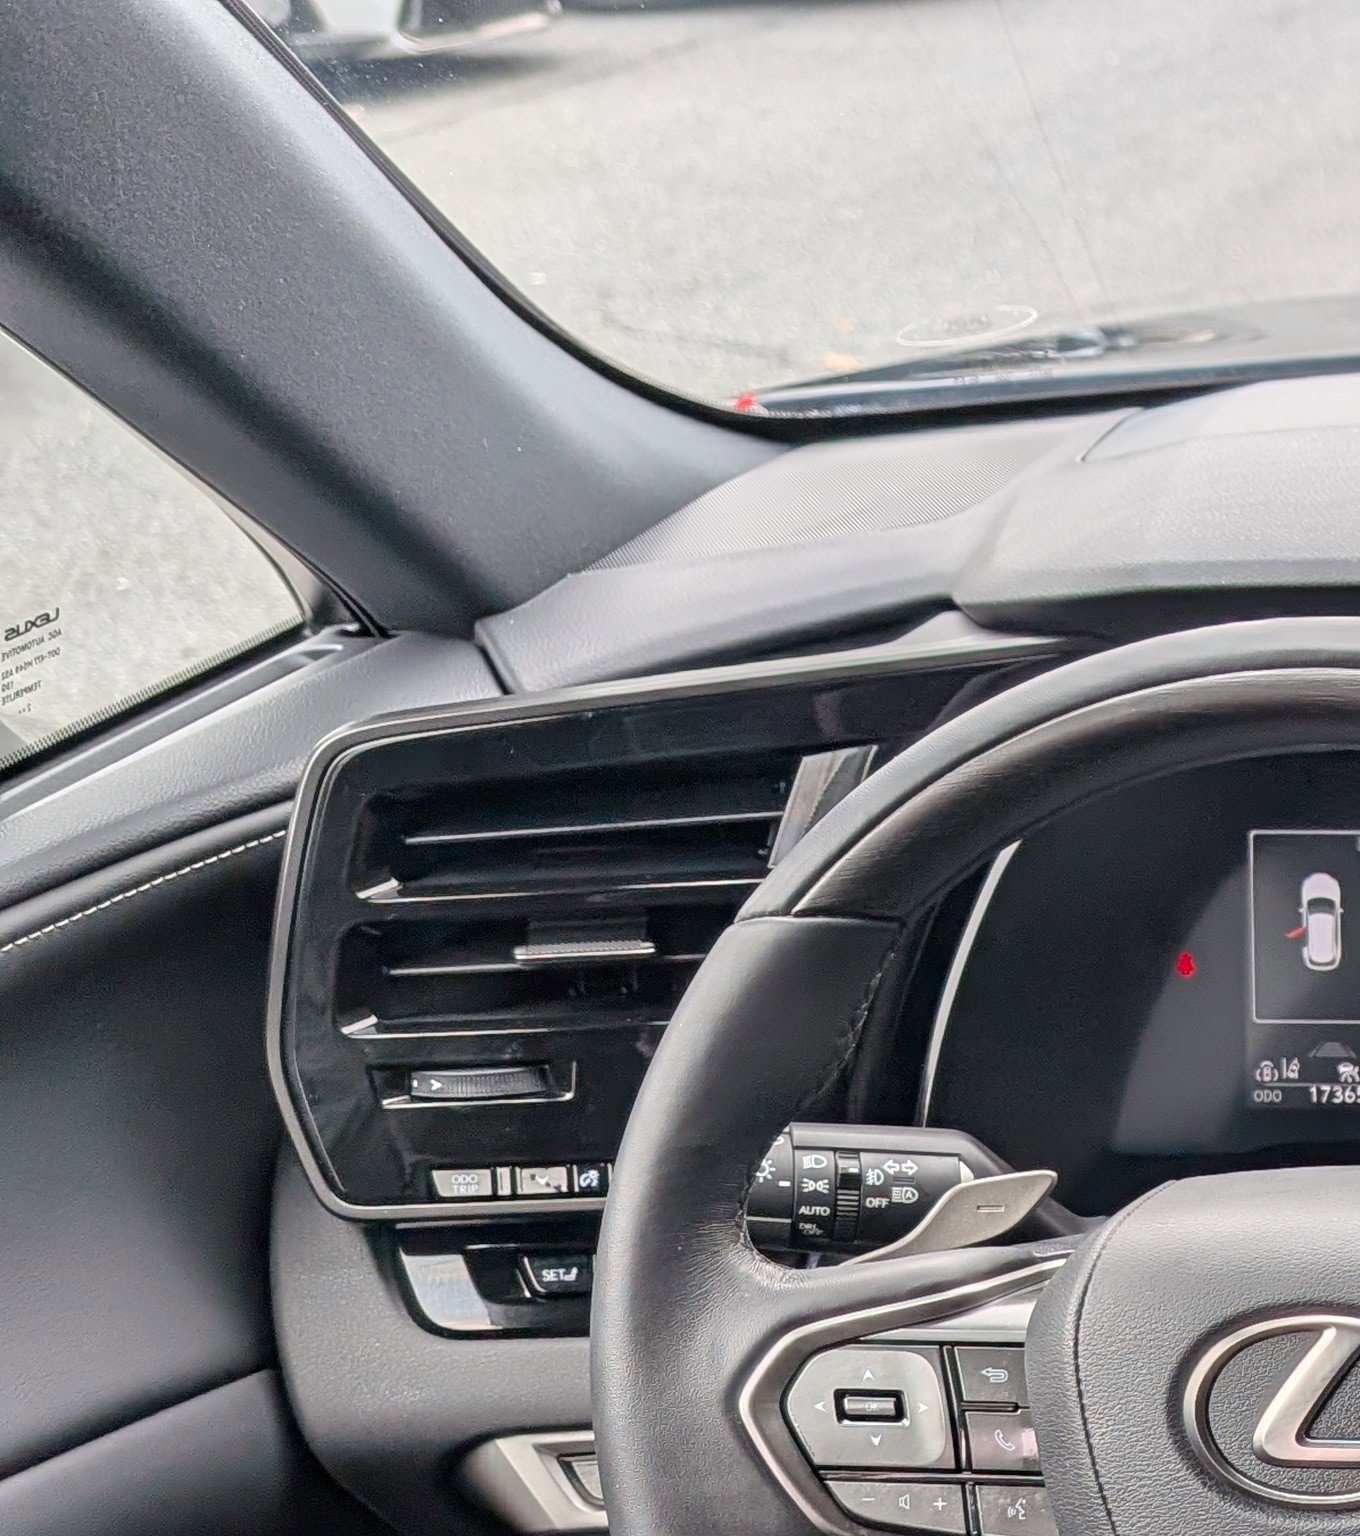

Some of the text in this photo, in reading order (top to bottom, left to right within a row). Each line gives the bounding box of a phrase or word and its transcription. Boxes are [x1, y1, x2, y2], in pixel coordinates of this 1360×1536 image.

[1253, 1090, 1282, 1103] ODO
[451, 1174, 478, 1184] ODO
[866, 1198, 890, 1209] OFF
[798, 1205, 831, 1216] AUTO
[541, 1269, 565, 1282] SET
